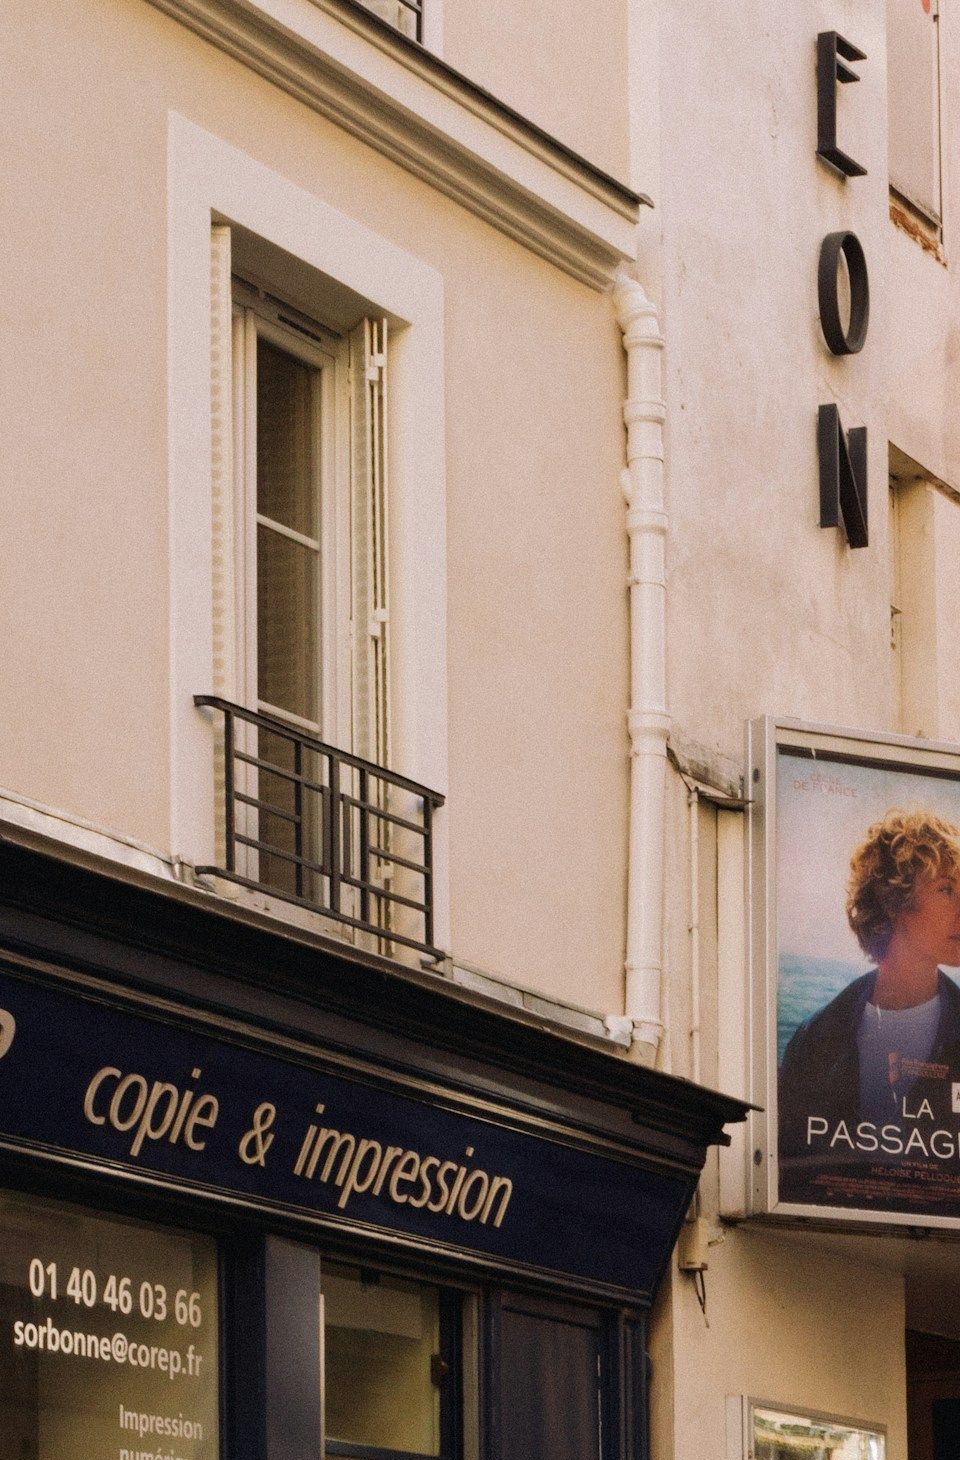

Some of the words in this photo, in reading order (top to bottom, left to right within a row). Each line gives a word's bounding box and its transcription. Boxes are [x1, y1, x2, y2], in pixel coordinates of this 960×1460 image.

[902, 1096, 935, 1121] LA
[83, 1066, 220, 1157] copie
[238, 1101, 277, 1168] &
[293, 1104, 514, 1229] impression
[29, 1258, 57, 1300] 01
[66, 1267, 97, 1307] 40
[103, 1275, 133, 1315] 46
[139, 1281, 168, 1321] 03
[175, 1289, 202, 1329] 66
[13, 1317, 203, 1380] sorbonne@corep.fr
[119, 1404, 203, 1440] Impression
